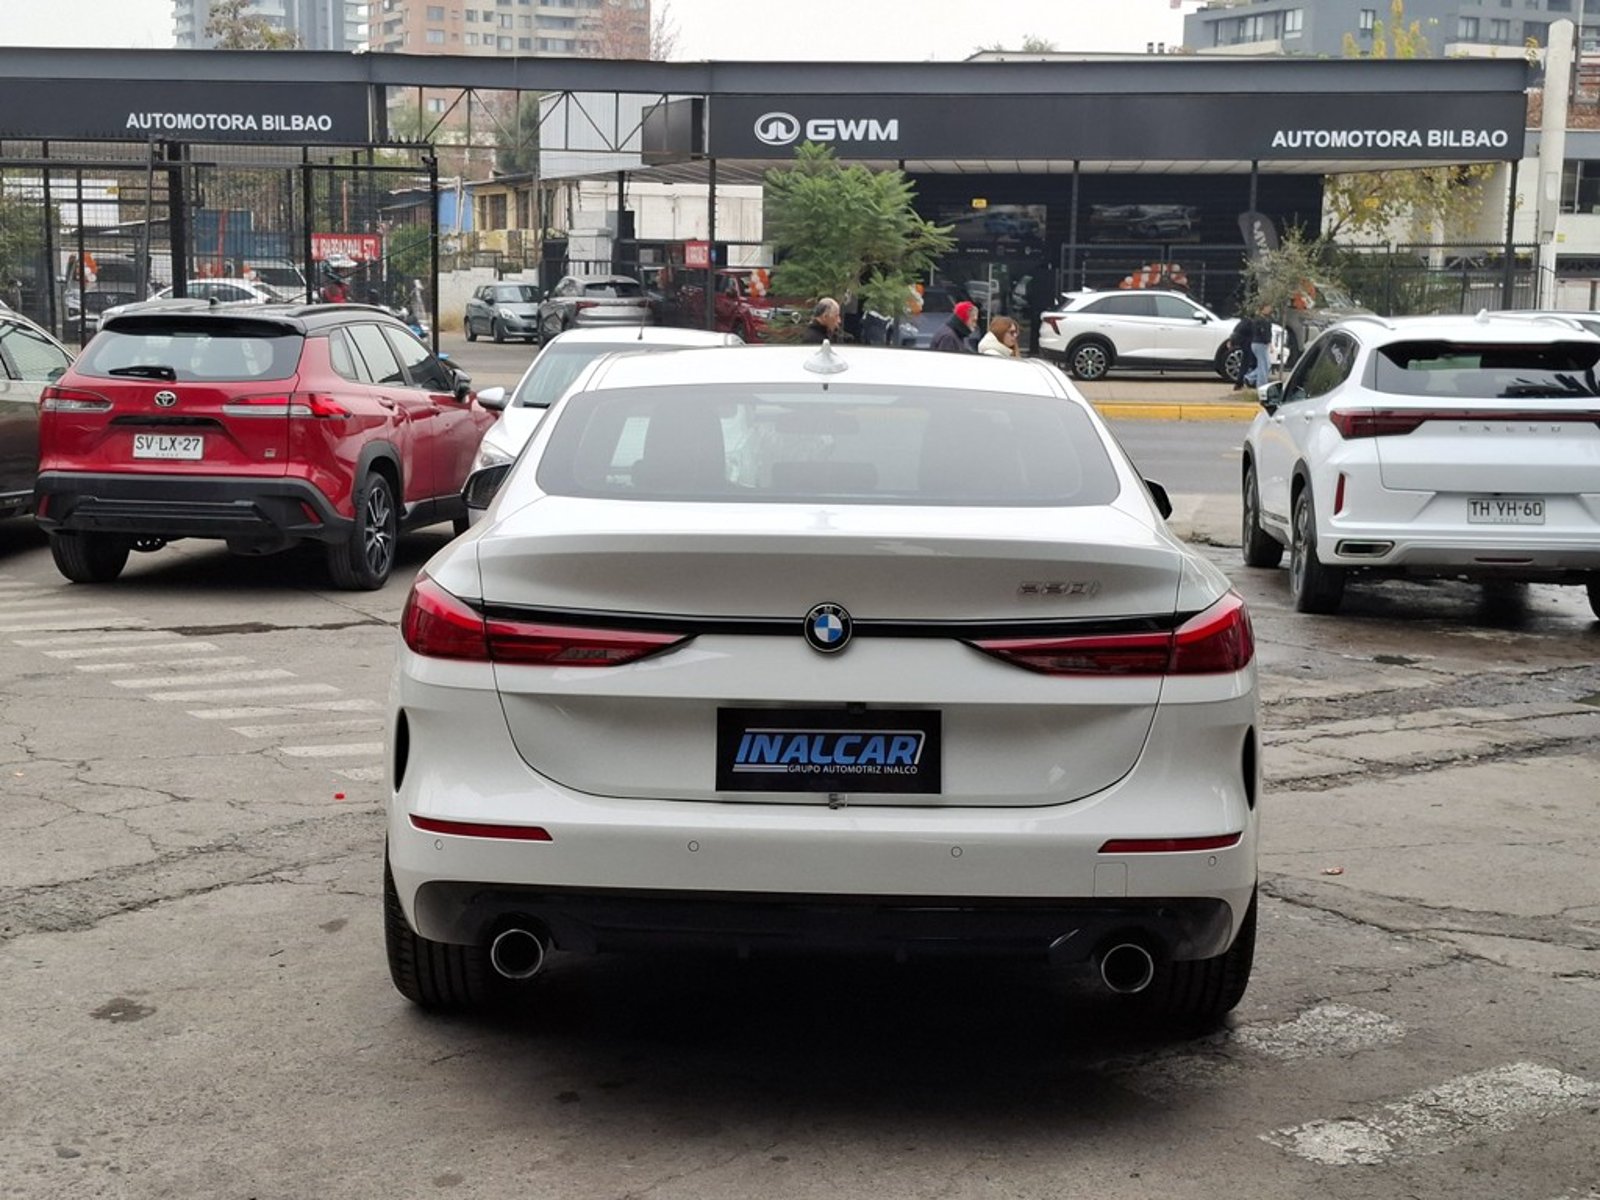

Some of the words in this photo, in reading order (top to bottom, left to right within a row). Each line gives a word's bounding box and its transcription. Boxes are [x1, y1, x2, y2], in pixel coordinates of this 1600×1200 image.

[126, 113, 257, 131] AUTOMOTORA
[261, 115, 332, 131] BILBAO
[806, 119, 899, 141] GWM
[1271, 130, 1422, 148] AUTOMOTORA
[1427, 129, 1508, 148] BILBAO
[735, 734, 917, 765] INALCAR
[788, 765, 820, 774] GRUPO
[822, 766, 881, 774] AUTOMOTRIZ
[883, 767, 918, 775] INALCO
